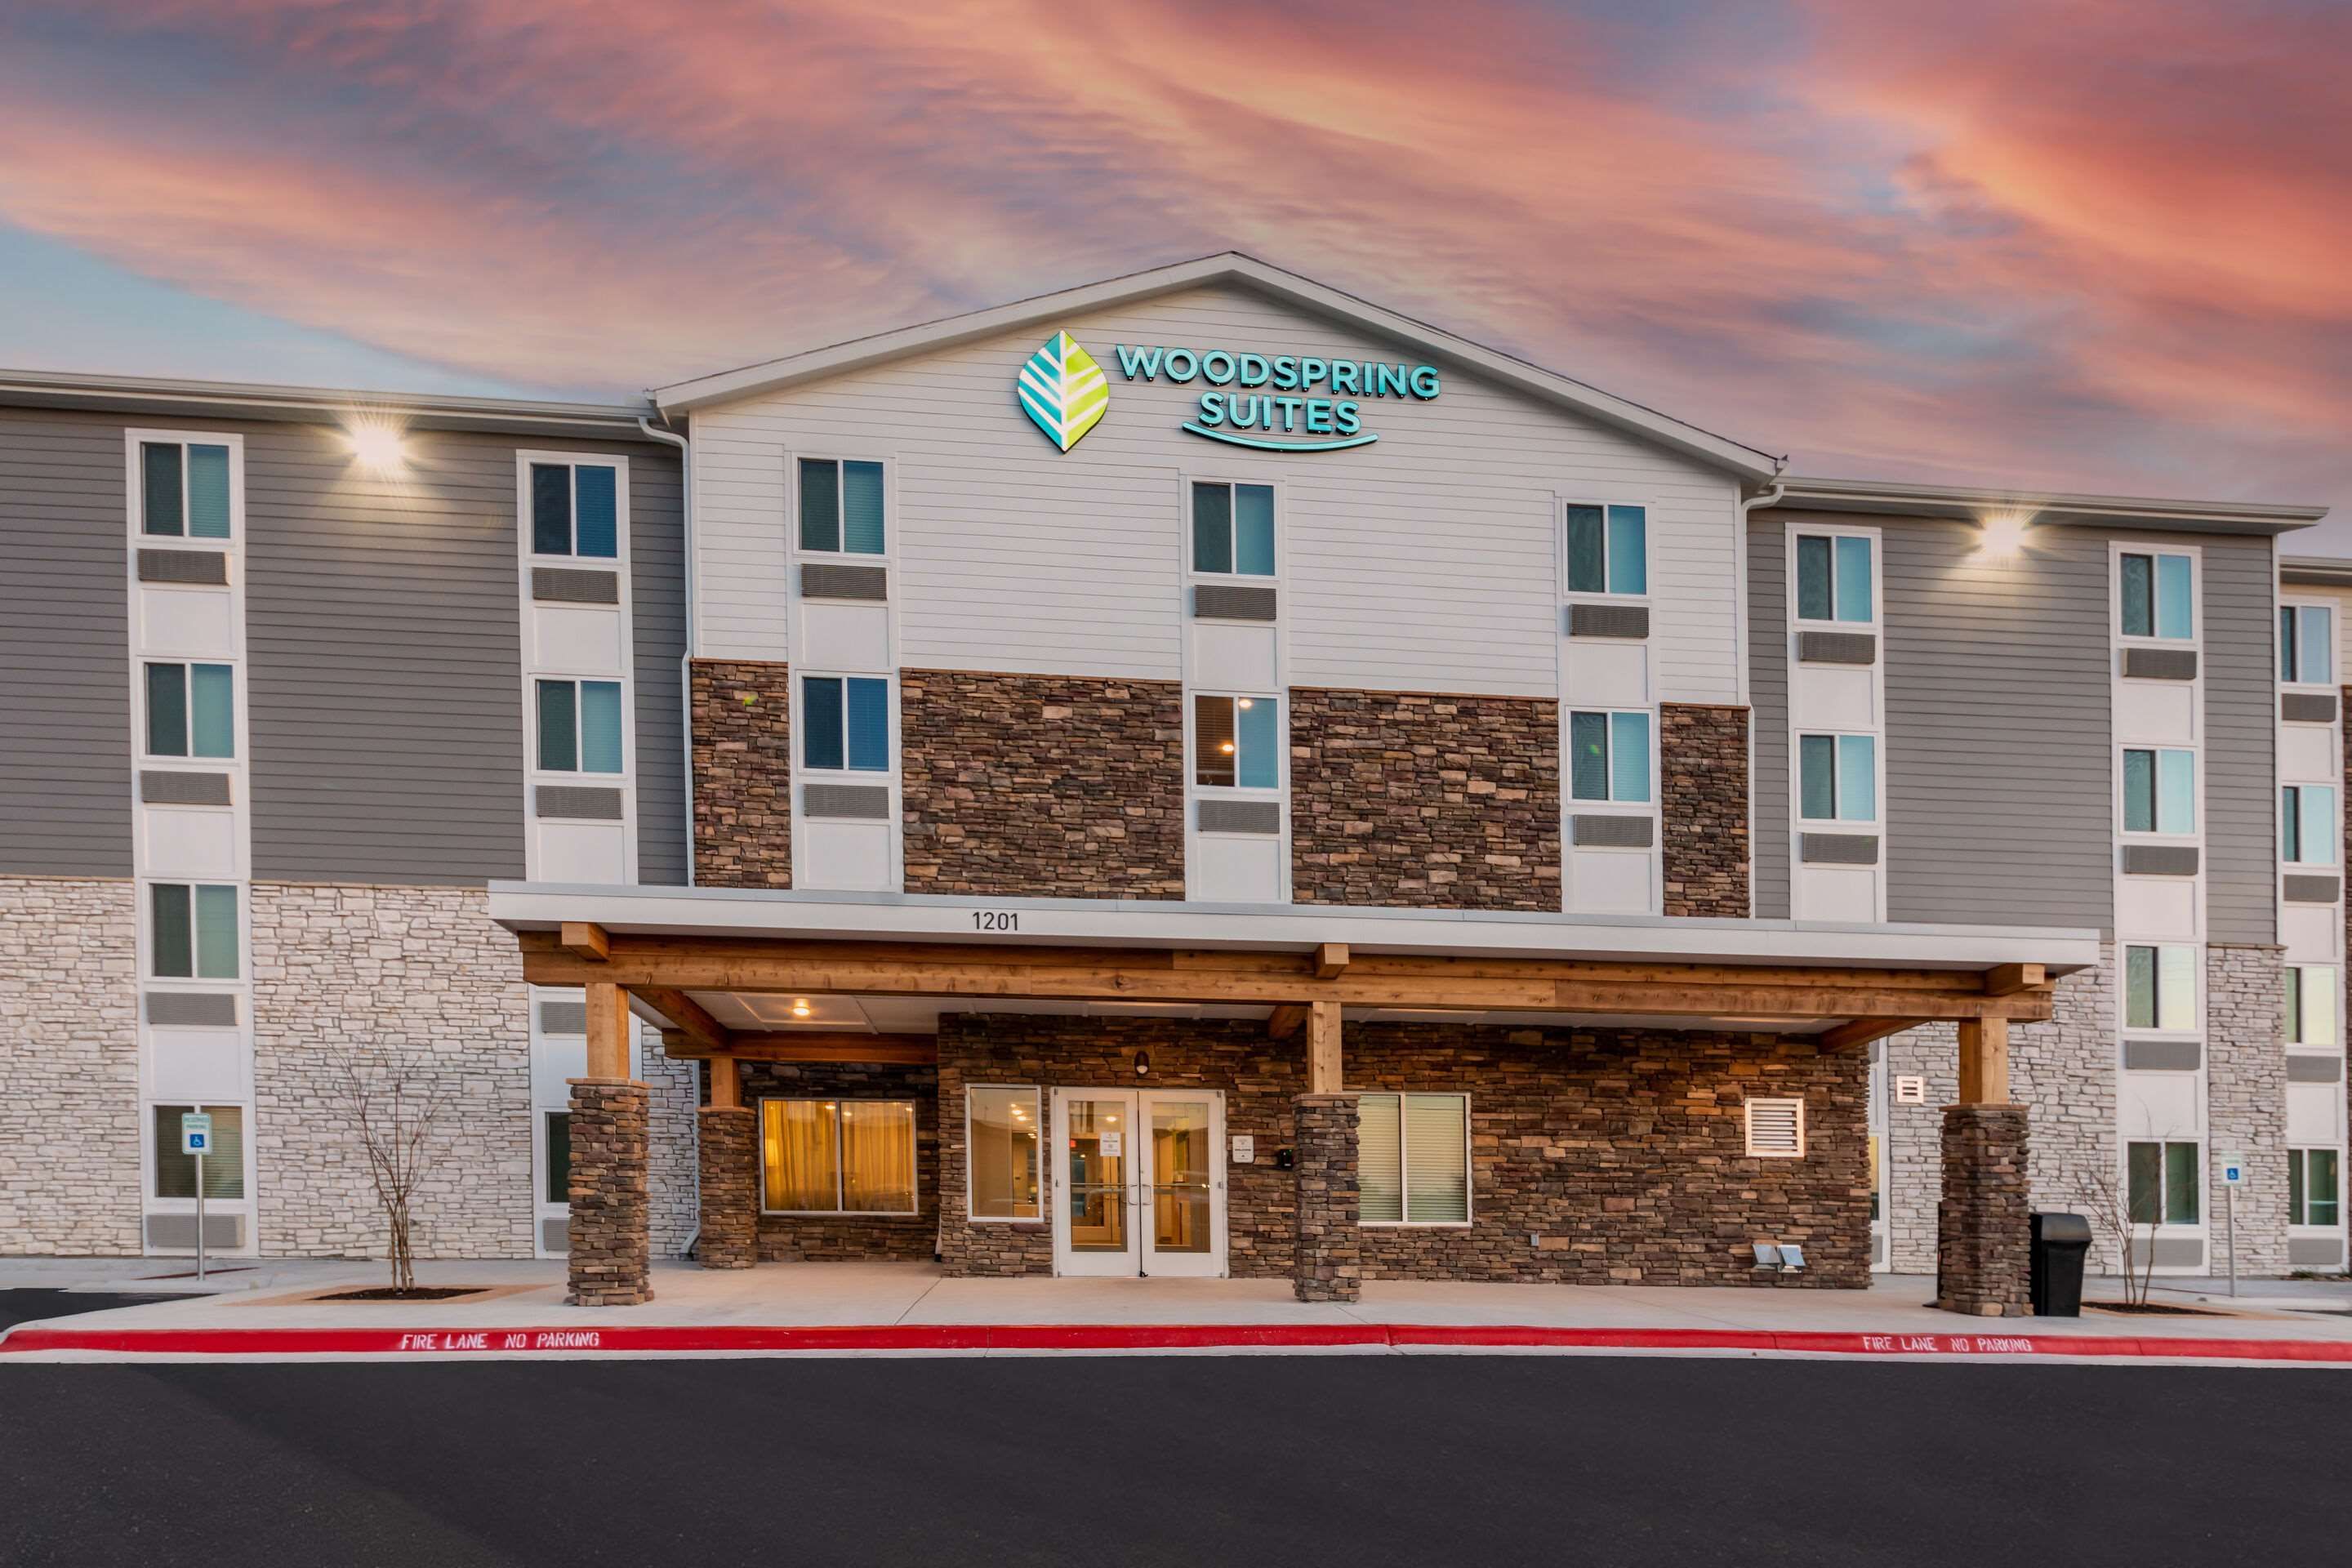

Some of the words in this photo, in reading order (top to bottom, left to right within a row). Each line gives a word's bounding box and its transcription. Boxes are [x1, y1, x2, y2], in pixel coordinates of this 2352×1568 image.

[1116, 344, 1440, 401] WOODSPRING
[1198, 391, 1362, 436] SUITES
[973, 911, 1018, 931] 1201
[401, 1334, 438, 1350] FIRE
[444, 1333, 488, 1349] LANE
[505, 1333, 527, 1348] NO
[537, 1332, 599, 1348] PARKING
[1862, 1336, 1895, 1351] FIRE
[1900, 1336, 1938, 1351] LANE
[1949, 1338, 1969, 1352] NO
[1977, 1338, 2033, 1352] PARKING
